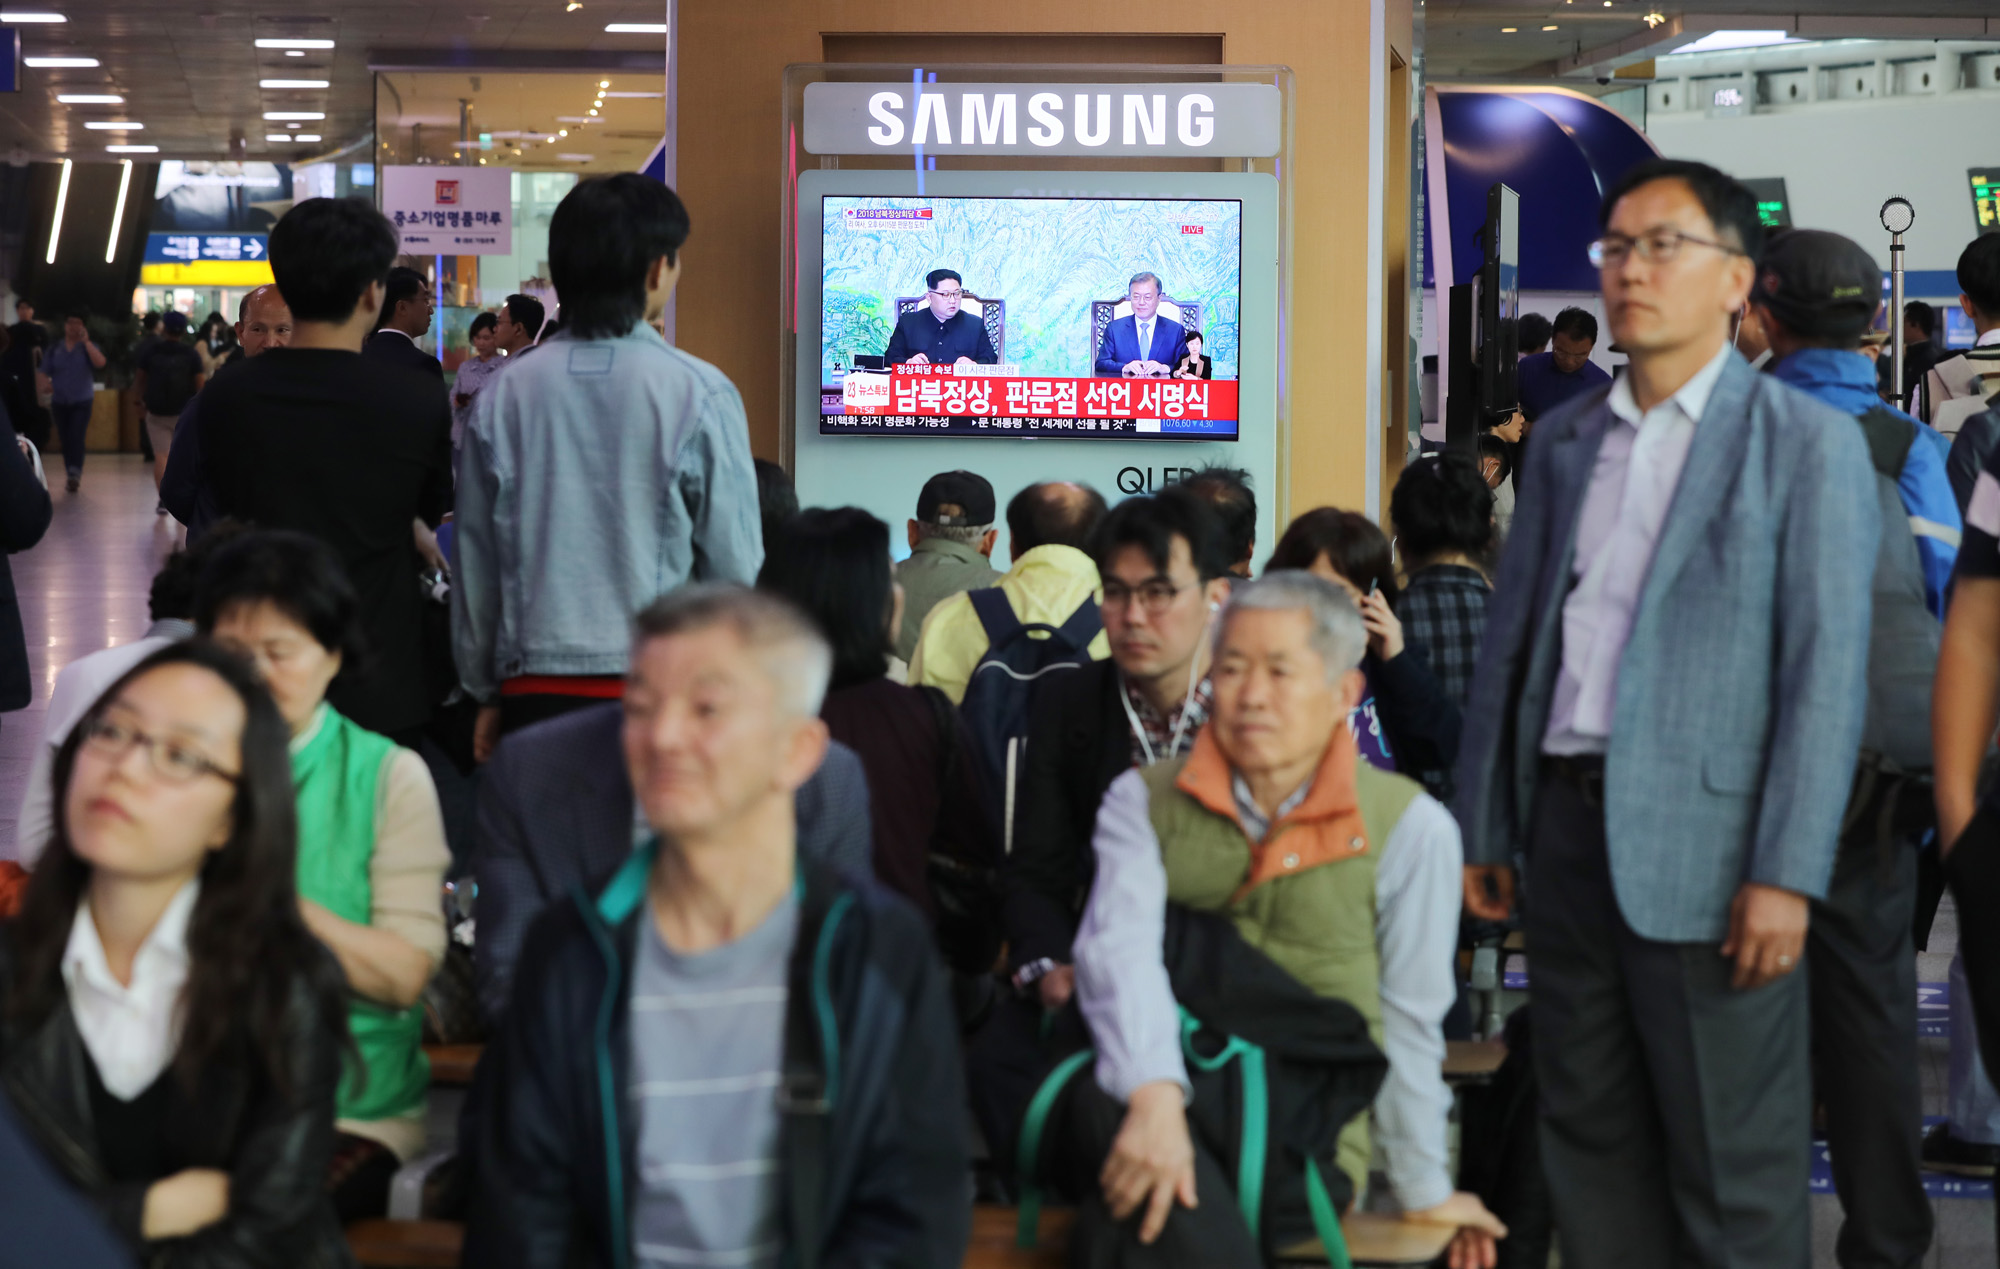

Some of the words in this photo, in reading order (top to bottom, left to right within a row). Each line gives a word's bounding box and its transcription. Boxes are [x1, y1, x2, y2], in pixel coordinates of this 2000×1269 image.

[868, 91, 1214, 147] SAMSUNG
[394, 211, 502, 228] 중소기업명품마루
[857, 209, 874, 218] 2018
[875, 209, 915, 219] 남북정상회담
[1183, 225, 1203, 234] LIVE
[896, 365, 932, 375] 정상회담
[934, 365, 953, 375] 속보
[958, 365, 967, 375] 이
[969, 366, 987, 375] 시각
[989, 366, 1015, 376] 판문점
[859, 384, 888, 396] 뉴스특보
[895, 379, 998, 416] 남북정상,
[1005, 381, 1077, 415] 판문점
[1083, 382, 1131, 416] 선언
[1137, 382, 1210, 418] 서명식
[827, 416, 858, 427] 비핵화
[860, 416, 882, 427] 의지
[884, 416, 916, 427] 명문화
[918, 416, 950, 428] 가능성
[978, 417, 989, 428] 문
[991, 417, 1023, 429] 대통령
[1041, 417, 1073, 430] 세계에
[1075, 418, 1097, 430] 선물
[1099, 418, 1110, 430] 될
